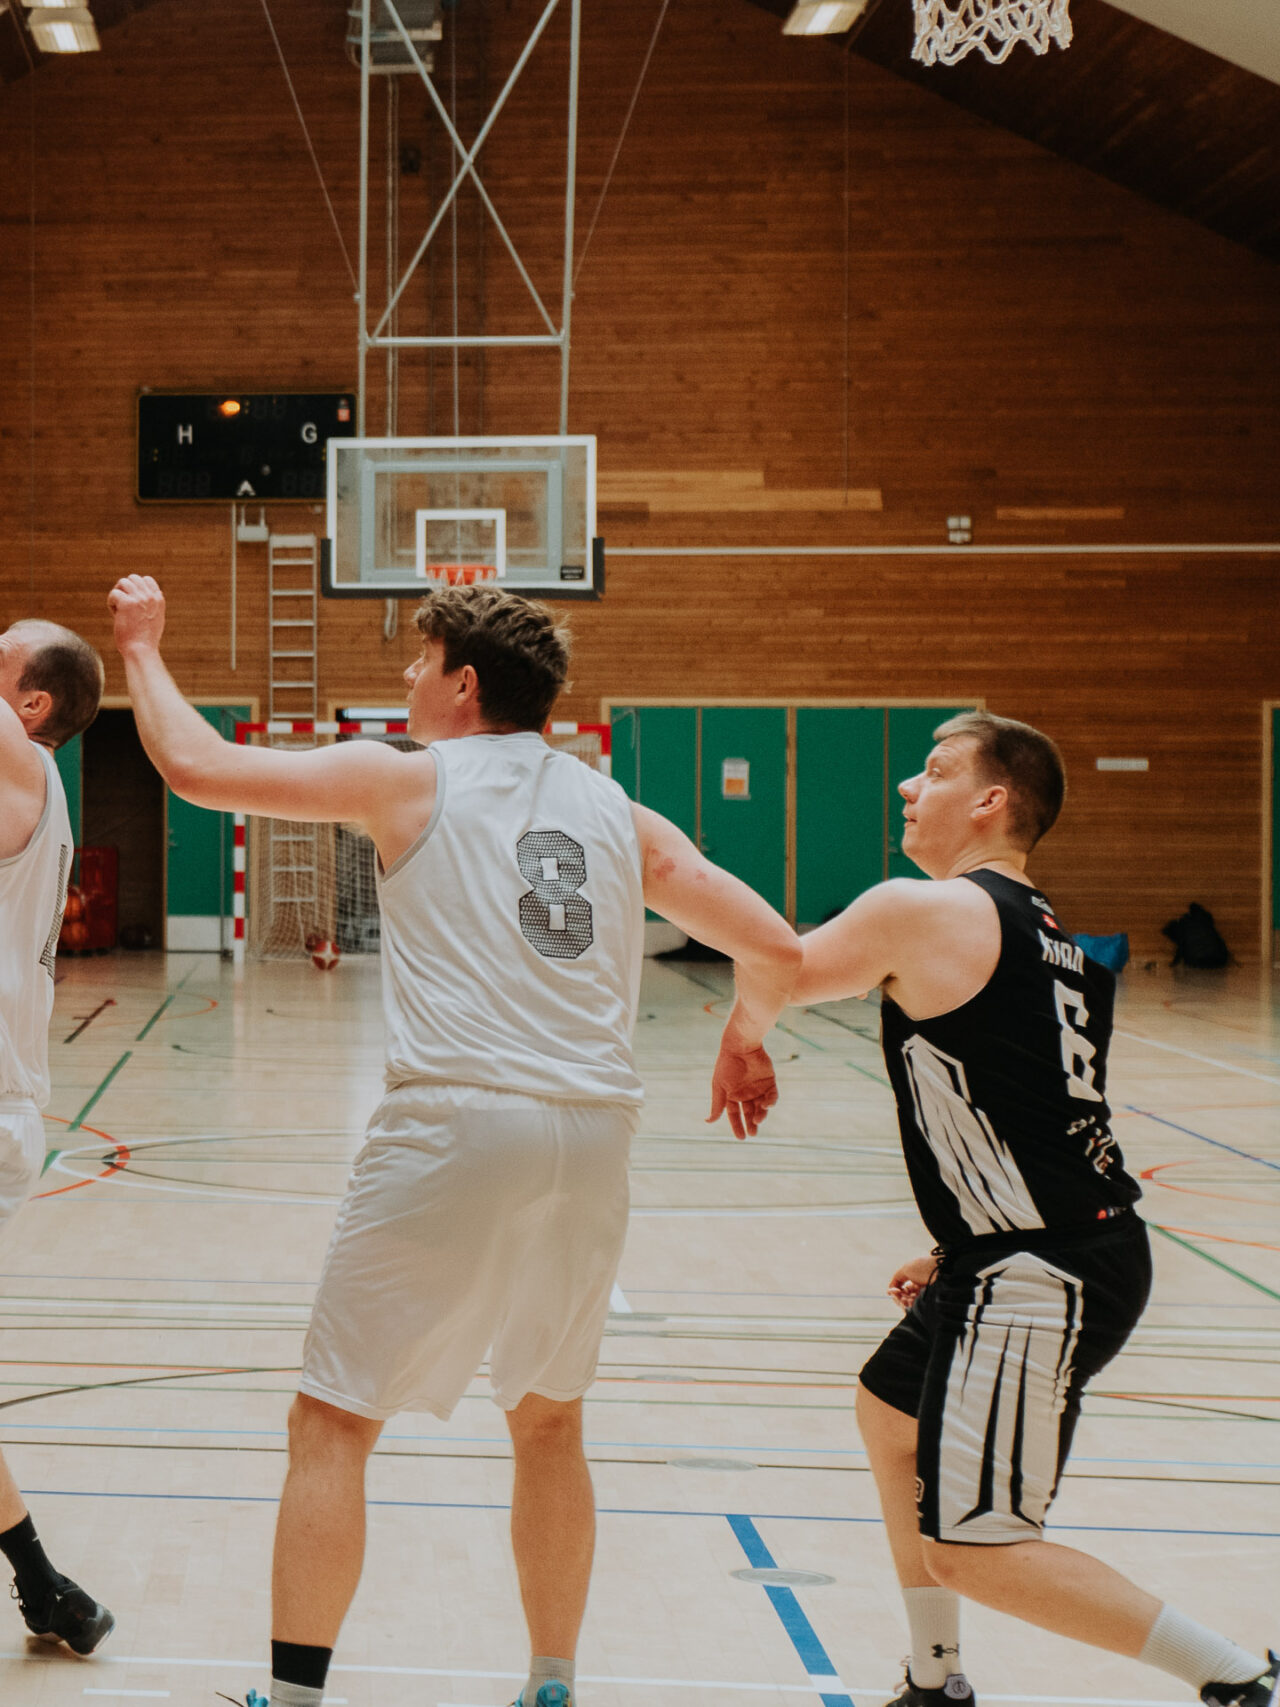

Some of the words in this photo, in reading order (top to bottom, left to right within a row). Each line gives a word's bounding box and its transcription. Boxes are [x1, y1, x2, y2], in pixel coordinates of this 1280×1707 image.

[178, 424, 193, 444] H
[301, 422, 317, 444] G
[516, 830, 594, 959] 8
[1053, 979, 1104, 1103] 6
